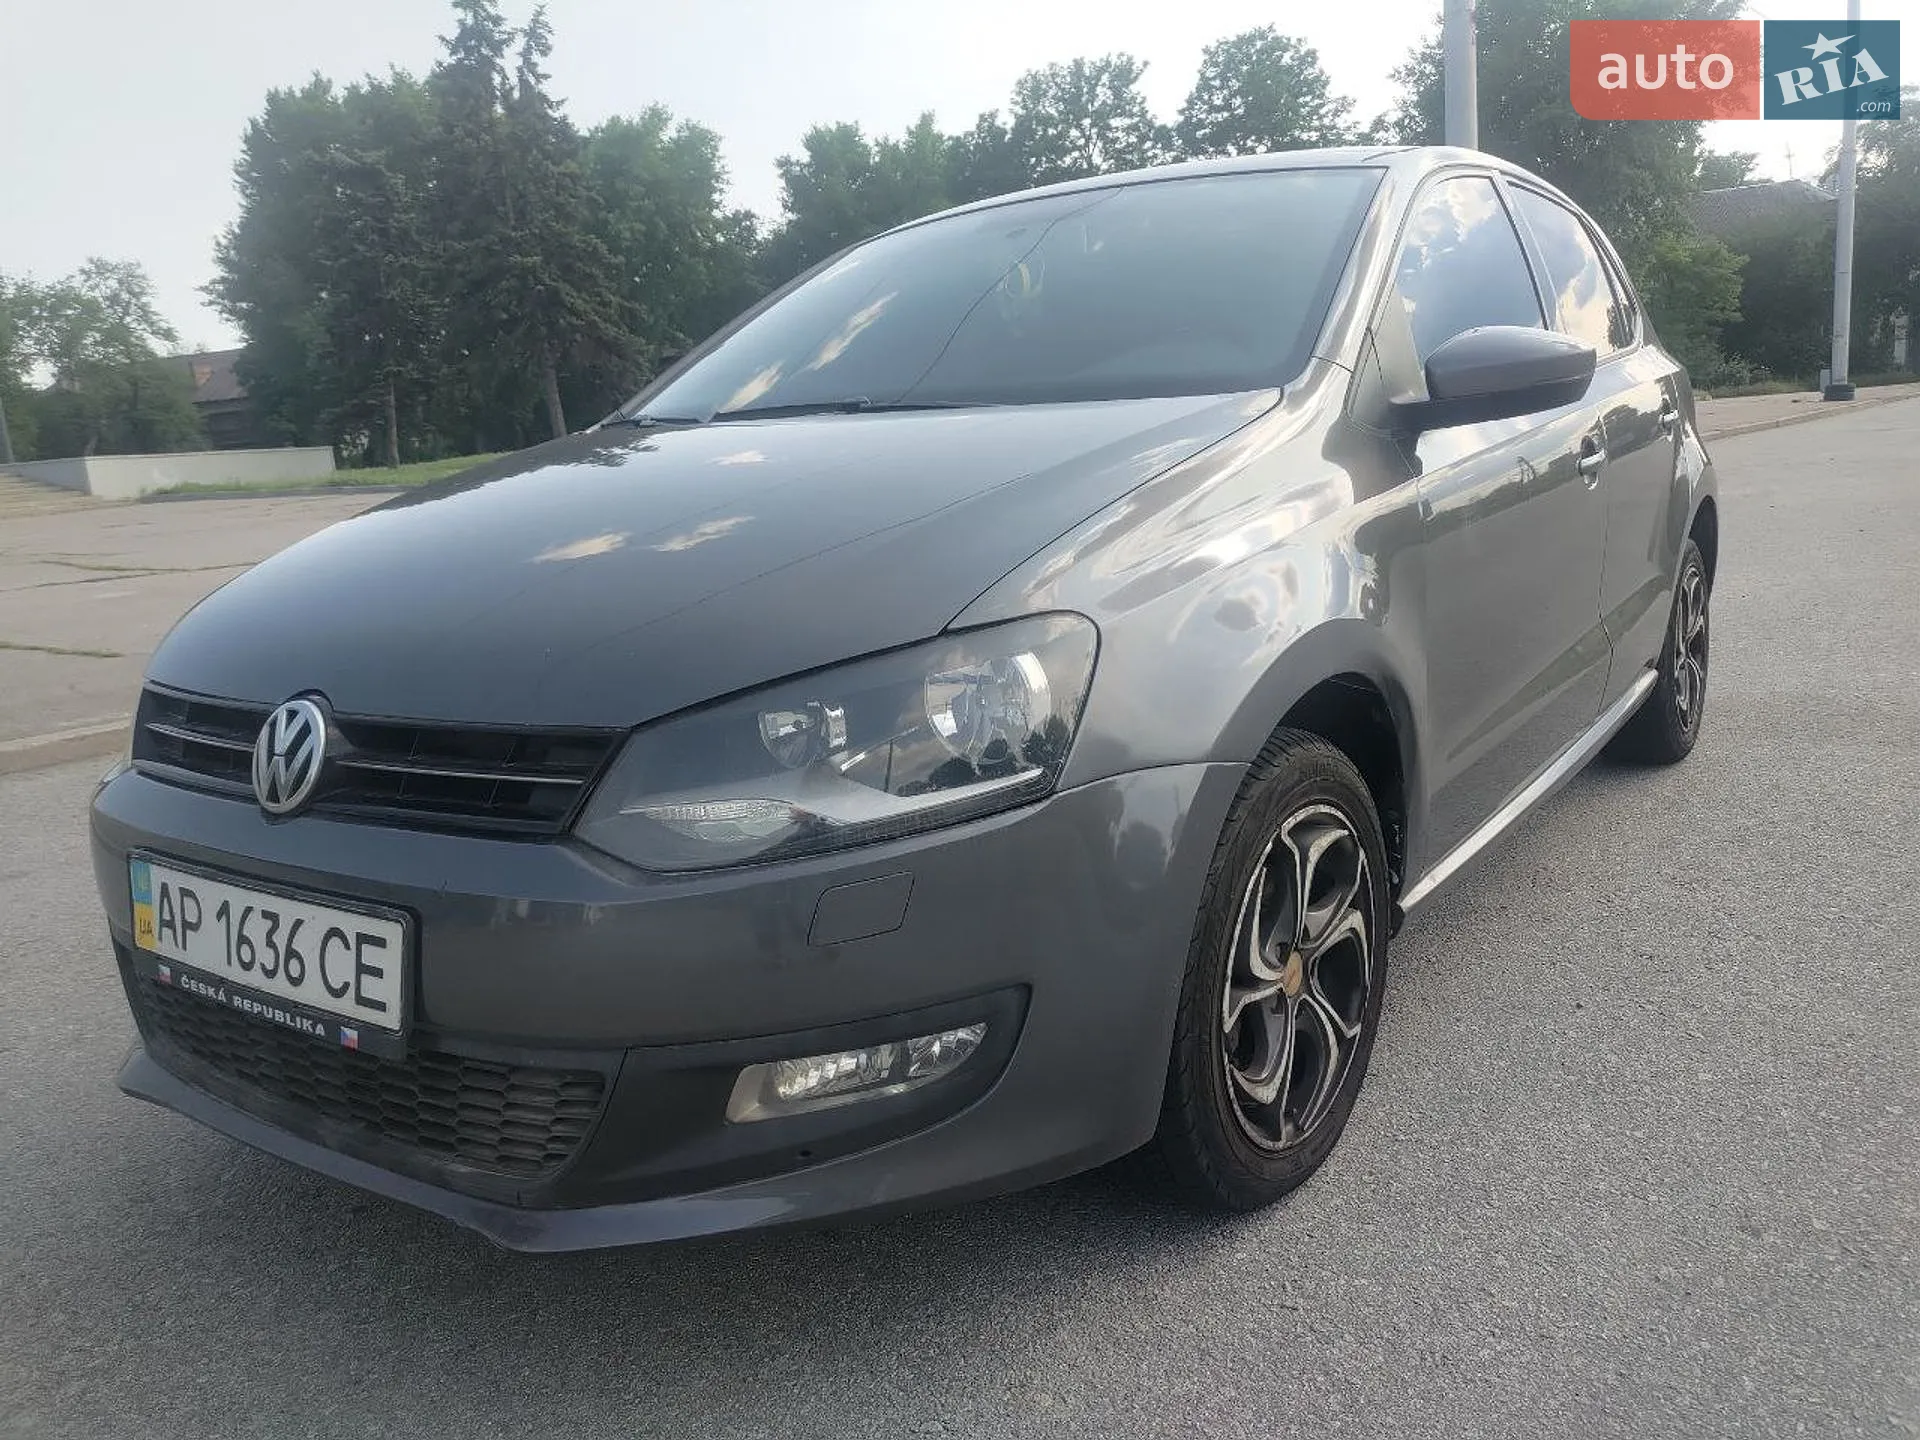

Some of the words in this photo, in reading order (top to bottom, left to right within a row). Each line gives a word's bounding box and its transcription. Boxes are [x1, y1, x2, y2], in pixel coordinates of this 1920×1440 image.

[139, 919, 154, 935] UA
[158, 881, 202, 951] AP
[216, 900, 305, 987] 1636
[319, 927, 387, 1013] CE
[233, 996, 325, 1037] REPUBLIKA
